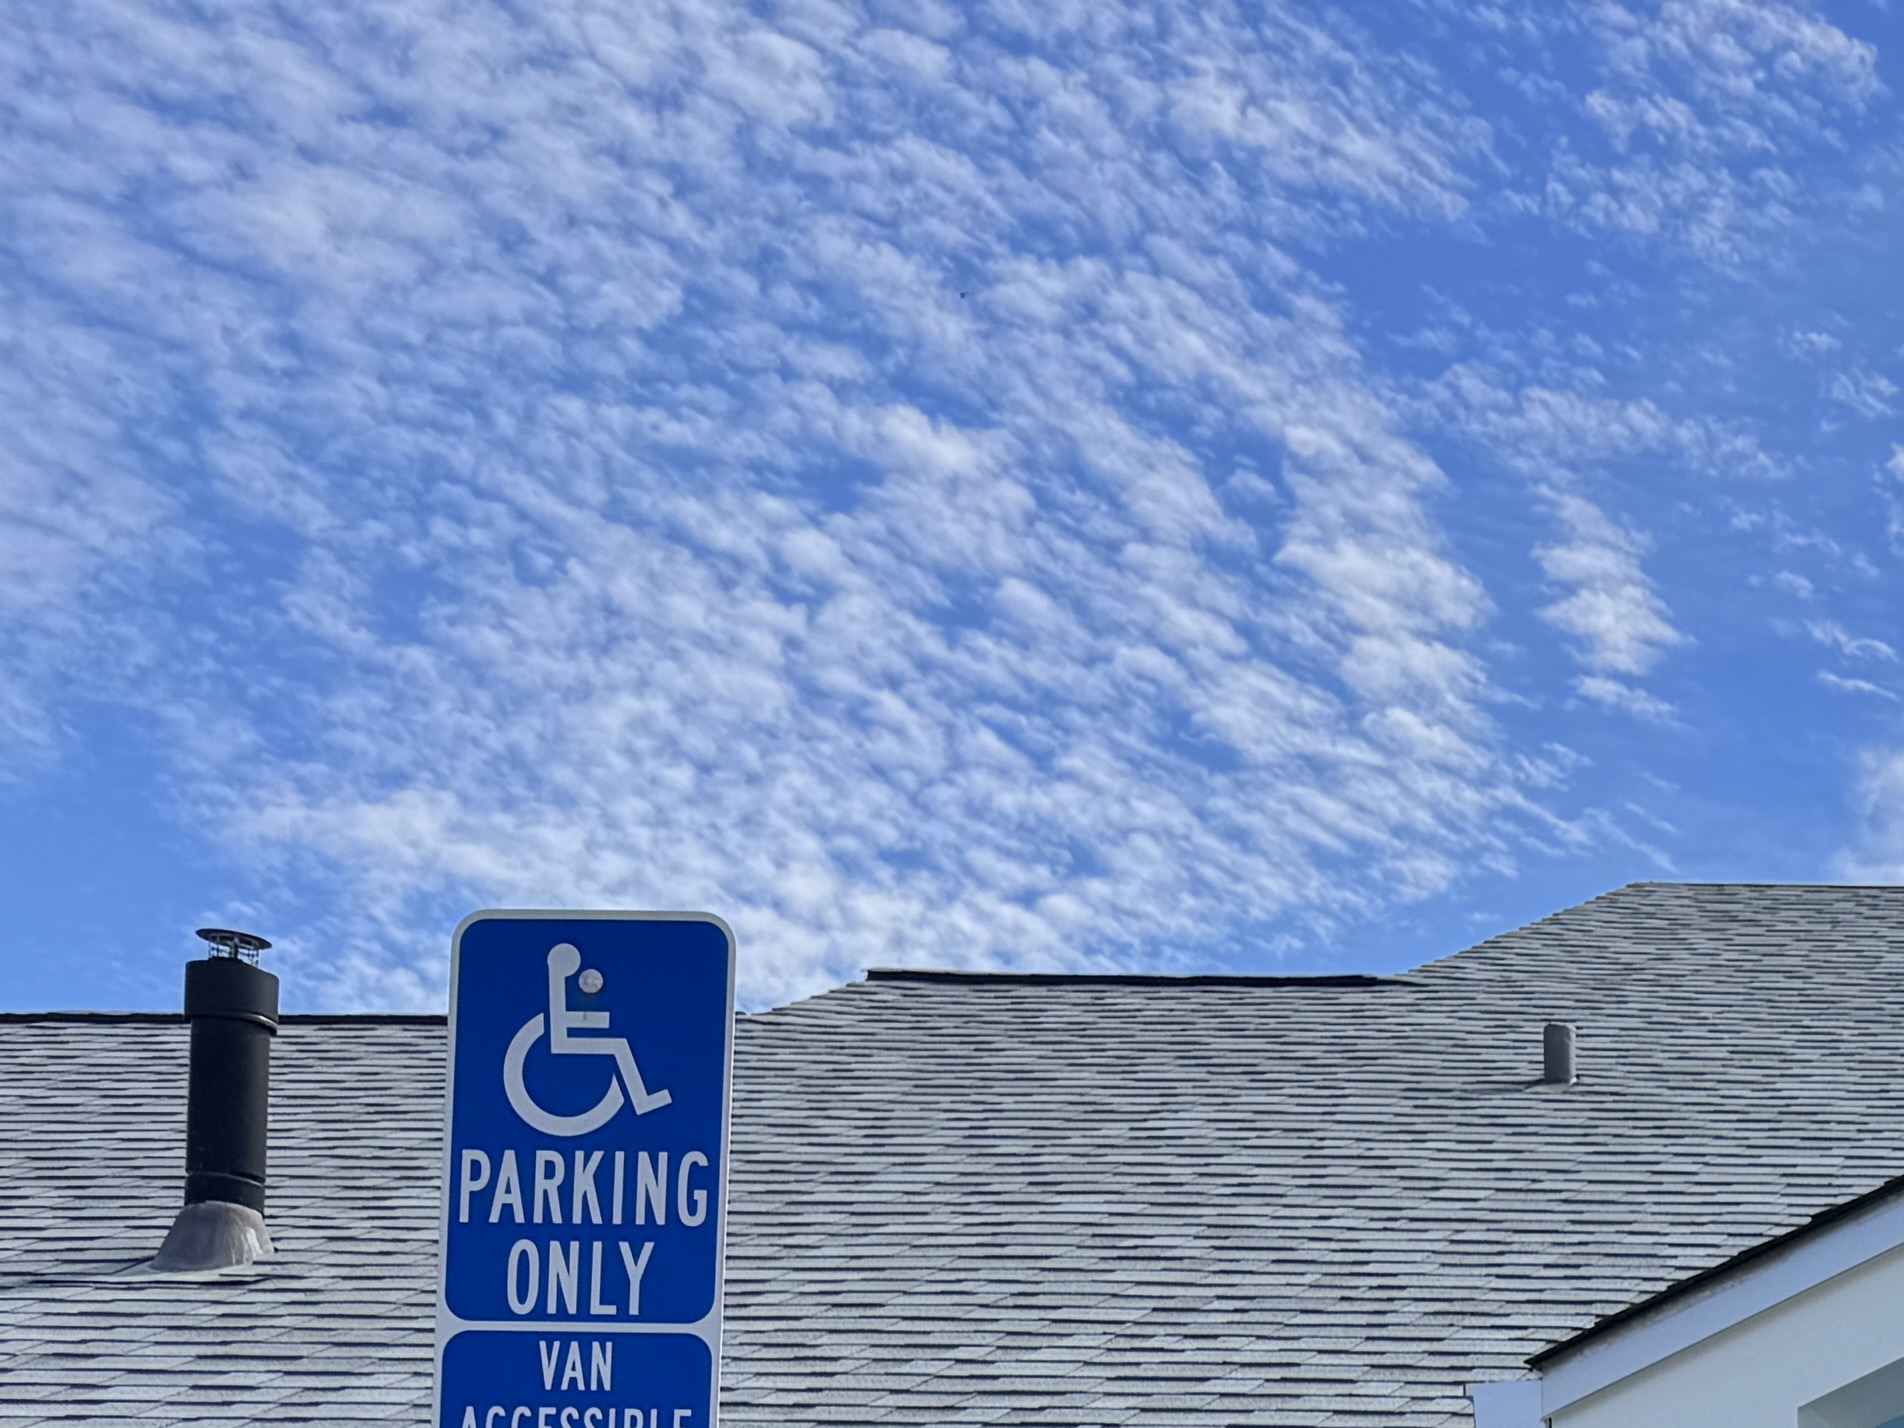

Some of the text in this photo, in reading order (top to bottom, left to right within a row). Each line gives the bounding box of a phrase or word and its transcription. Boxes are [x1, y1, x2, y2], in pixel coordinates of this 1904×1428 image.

[458, 1150, 709, 1227] PARKING
[506, 1239, 655, 1316] ONLY
[539, 1340, 613, 1392] VAN
